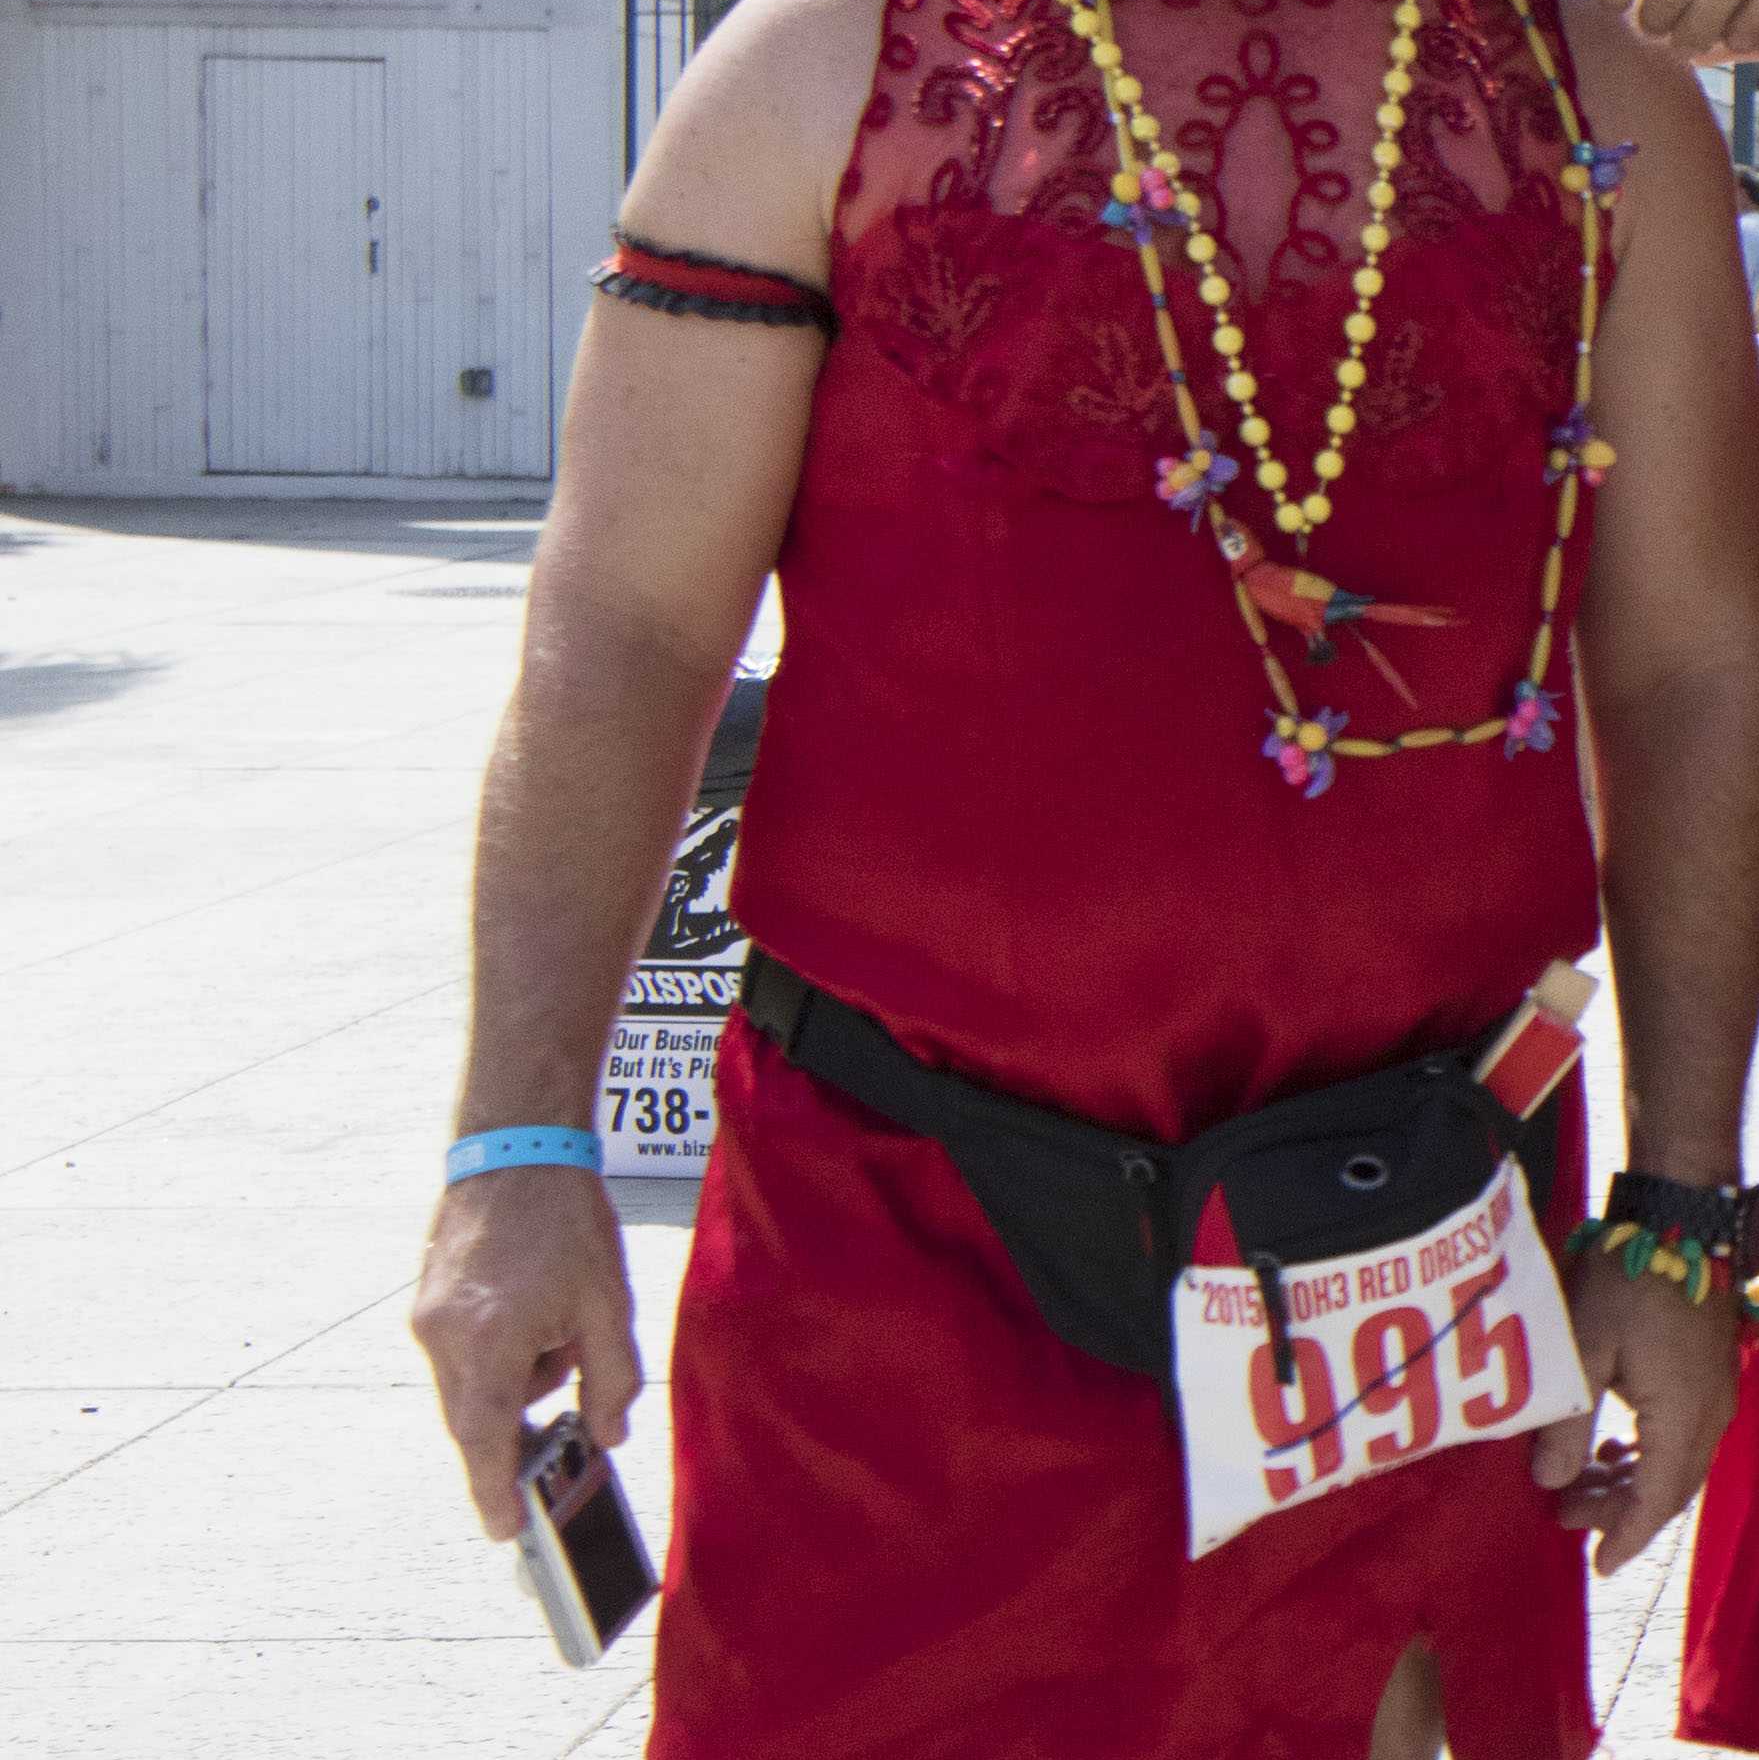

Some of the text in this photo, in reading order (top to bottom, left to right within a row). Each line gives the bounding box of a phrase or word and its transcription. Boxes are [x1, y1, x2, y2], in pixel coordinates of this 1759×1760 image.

[608, 1055, 644, 1078] But
[649, 1056, 683, 1079] It's
[614, 1027, 649, 1051] Our
[1202, 1213, 1491, 1328] 2015 OH3 RED DRESS
[1248, 1254, 1534, 1505] 995
